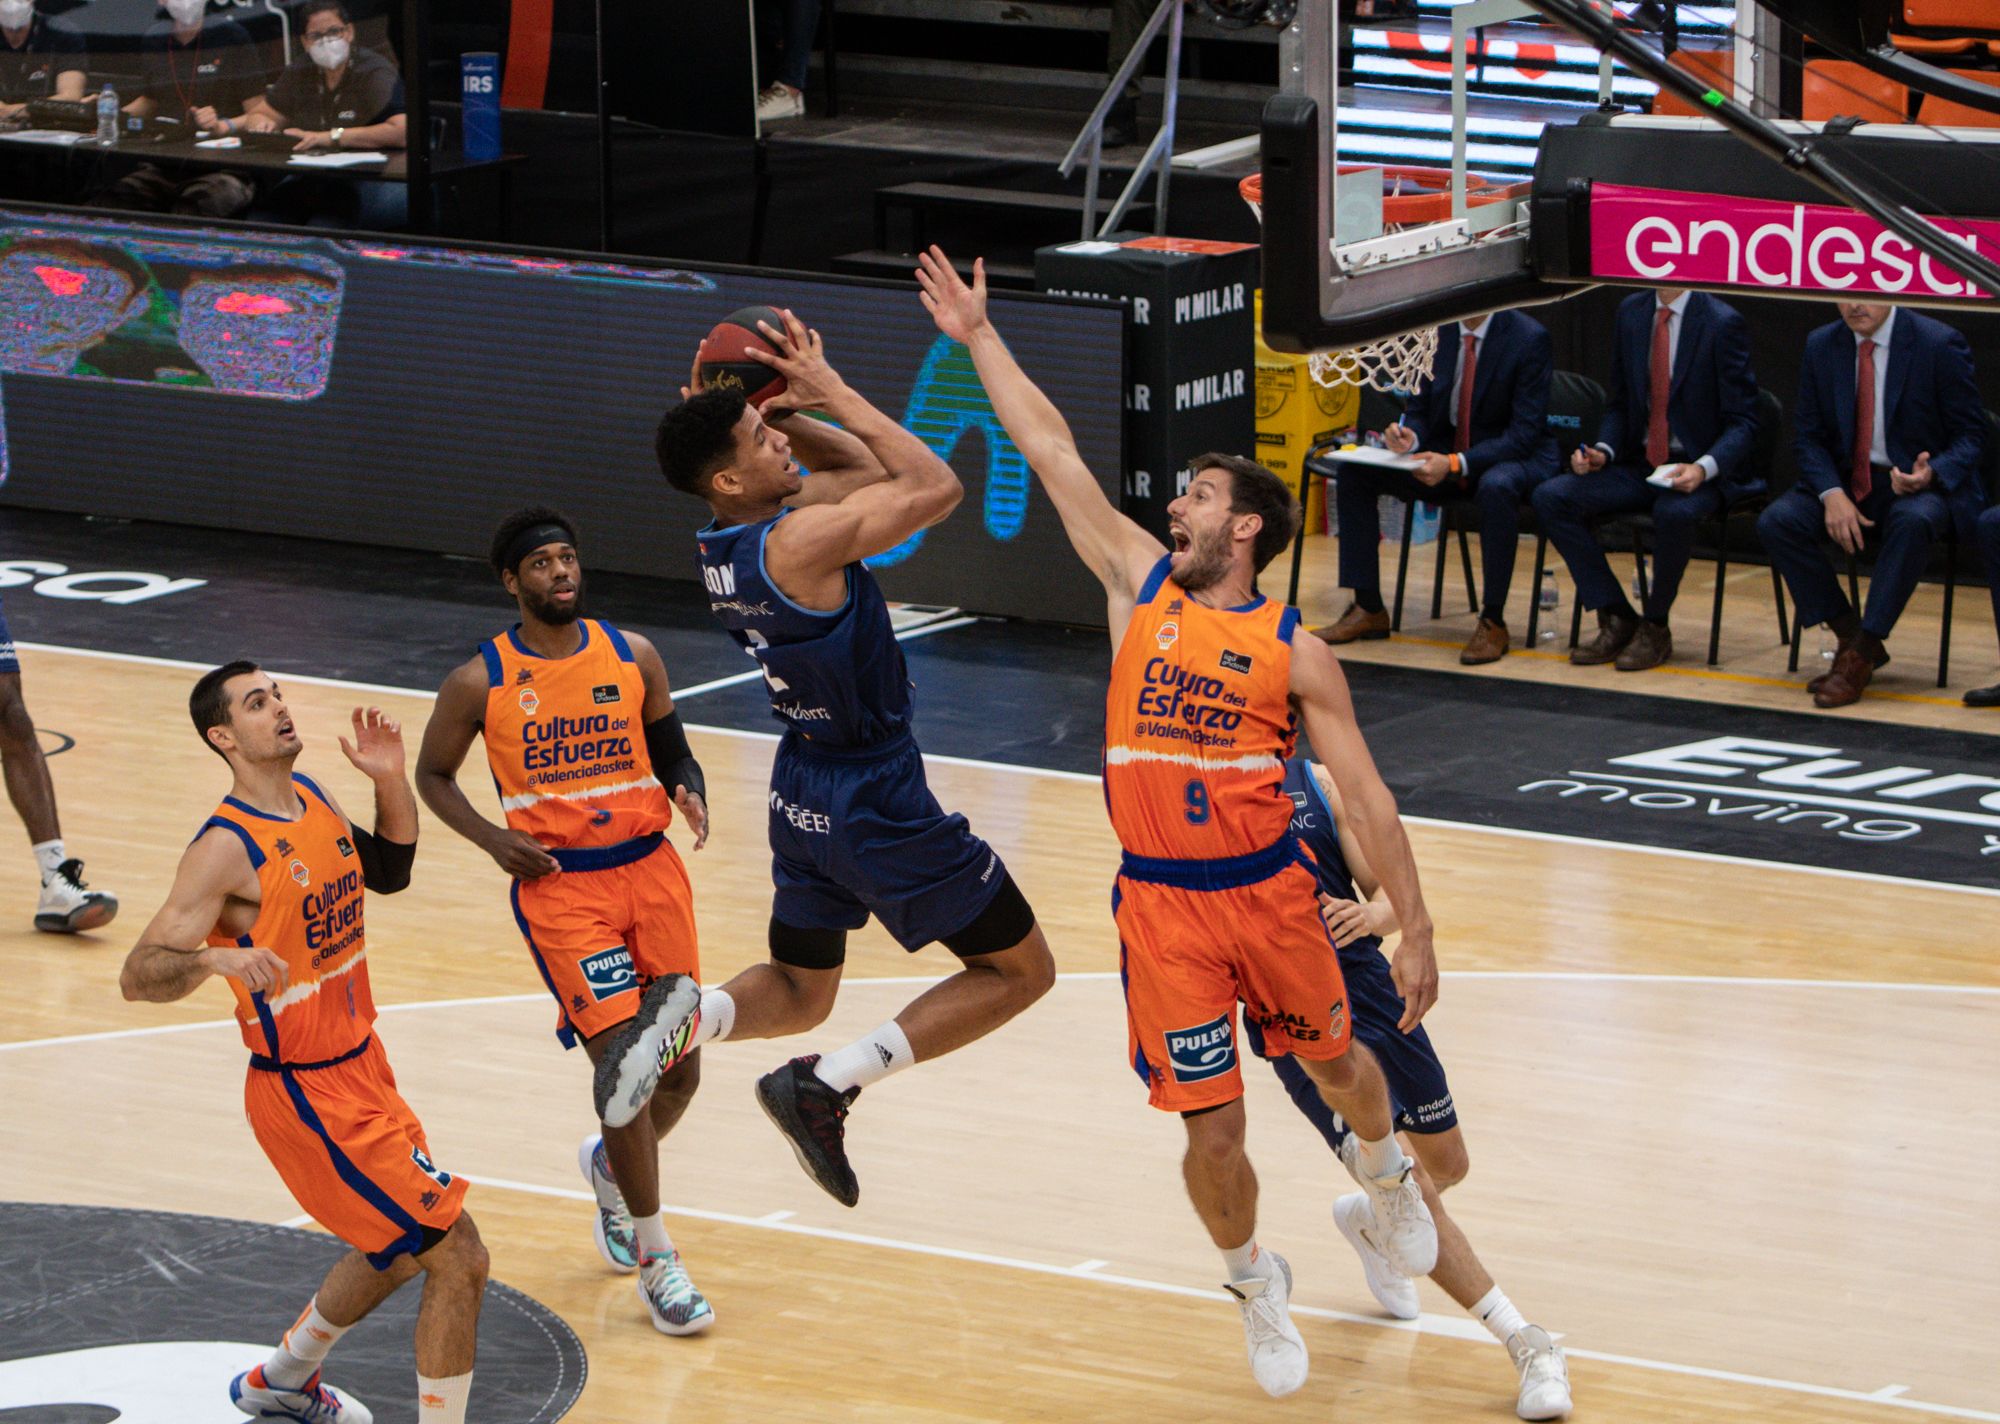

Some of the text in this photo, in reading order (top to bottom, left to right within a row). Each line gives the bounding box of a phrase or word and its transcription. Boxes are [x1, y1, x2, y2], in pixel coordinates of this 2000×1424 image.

[463, 75, 494, 93] IRS
[1625, 204, 1978, 296] endesa
[1192, 283, 1244, 321] MILAR
[1192, 368, 1245, 407] MILAR
[522, 714, 630, 745] Cultura del
[523, 736, 633, 771] Esfuerzo
[527, 758, 636, 787] @ValenciaBasket
[1606, 735, 2000, 810] Eur
[1184, 777, 1211, 826] 9
[1517, 778, 1923, 842] moving
[302, 869, 357, 921] Cultura
